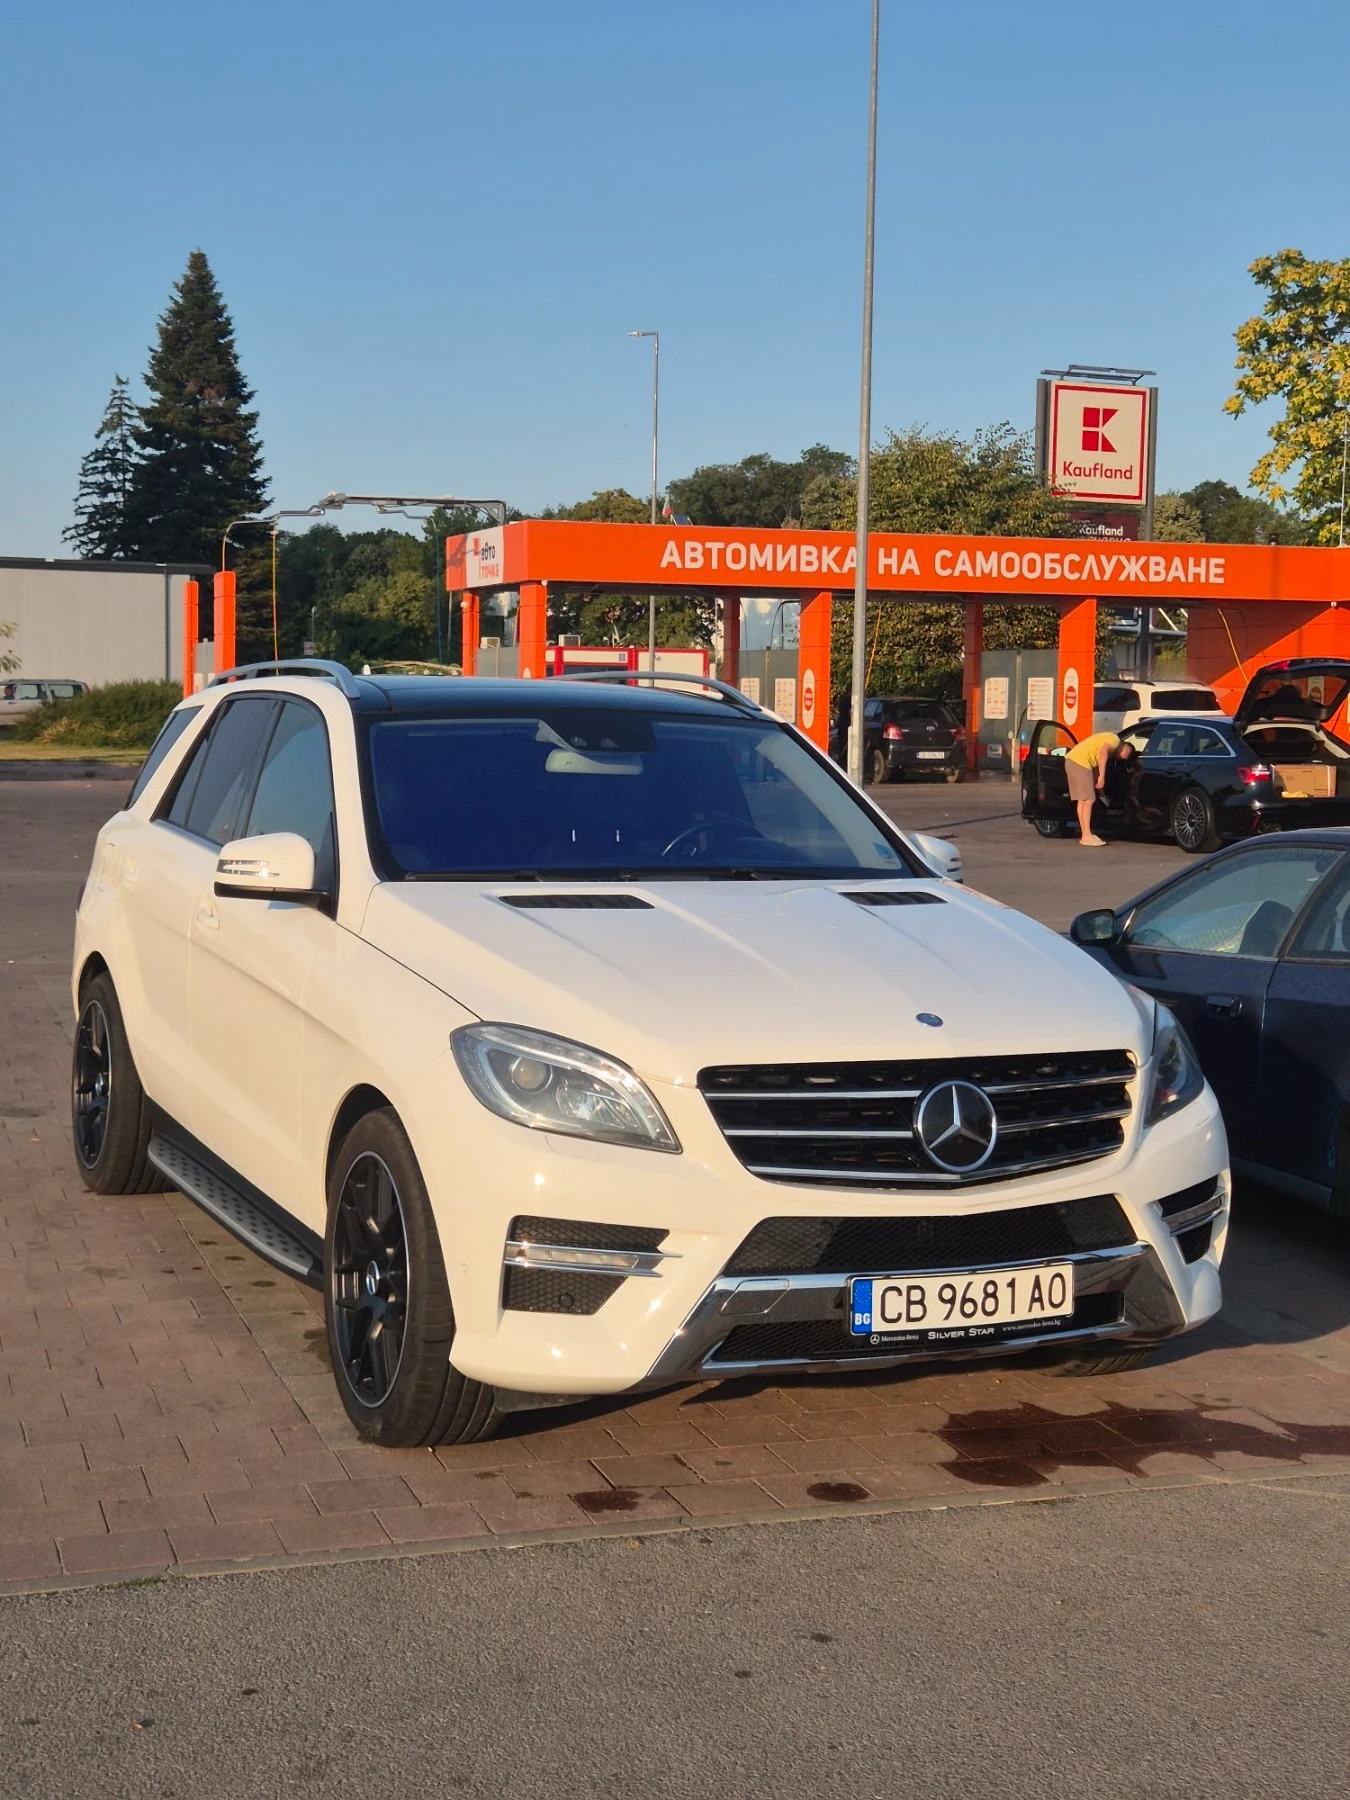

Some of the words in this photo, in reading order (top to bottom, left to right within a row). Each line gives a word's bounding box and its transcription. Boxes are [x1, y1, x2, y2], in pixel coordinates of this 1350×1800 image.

[1063, 461, 1133, 480] Kaufland
[1079, 525, 1124, 536] Kaufland
[660, 540, 857, 574] АВТОМИВКА
[877, 547, 921, 576] НА
[934, 548, 1225, 584] САМООБСЛУЖВАНЕ
[880, 1284, 928, 1324] CB
[938, 1276, 1016, 1321] 9681
[1028, 1272, 1067, 1313] AO
[854, 1312, 871, 1326] BG
[881, 1334, 919, 1343] Mercedes-Benz
[928, 1330, 965, 1340] SILVER
[968, 1327, 995, 1337] STAR
